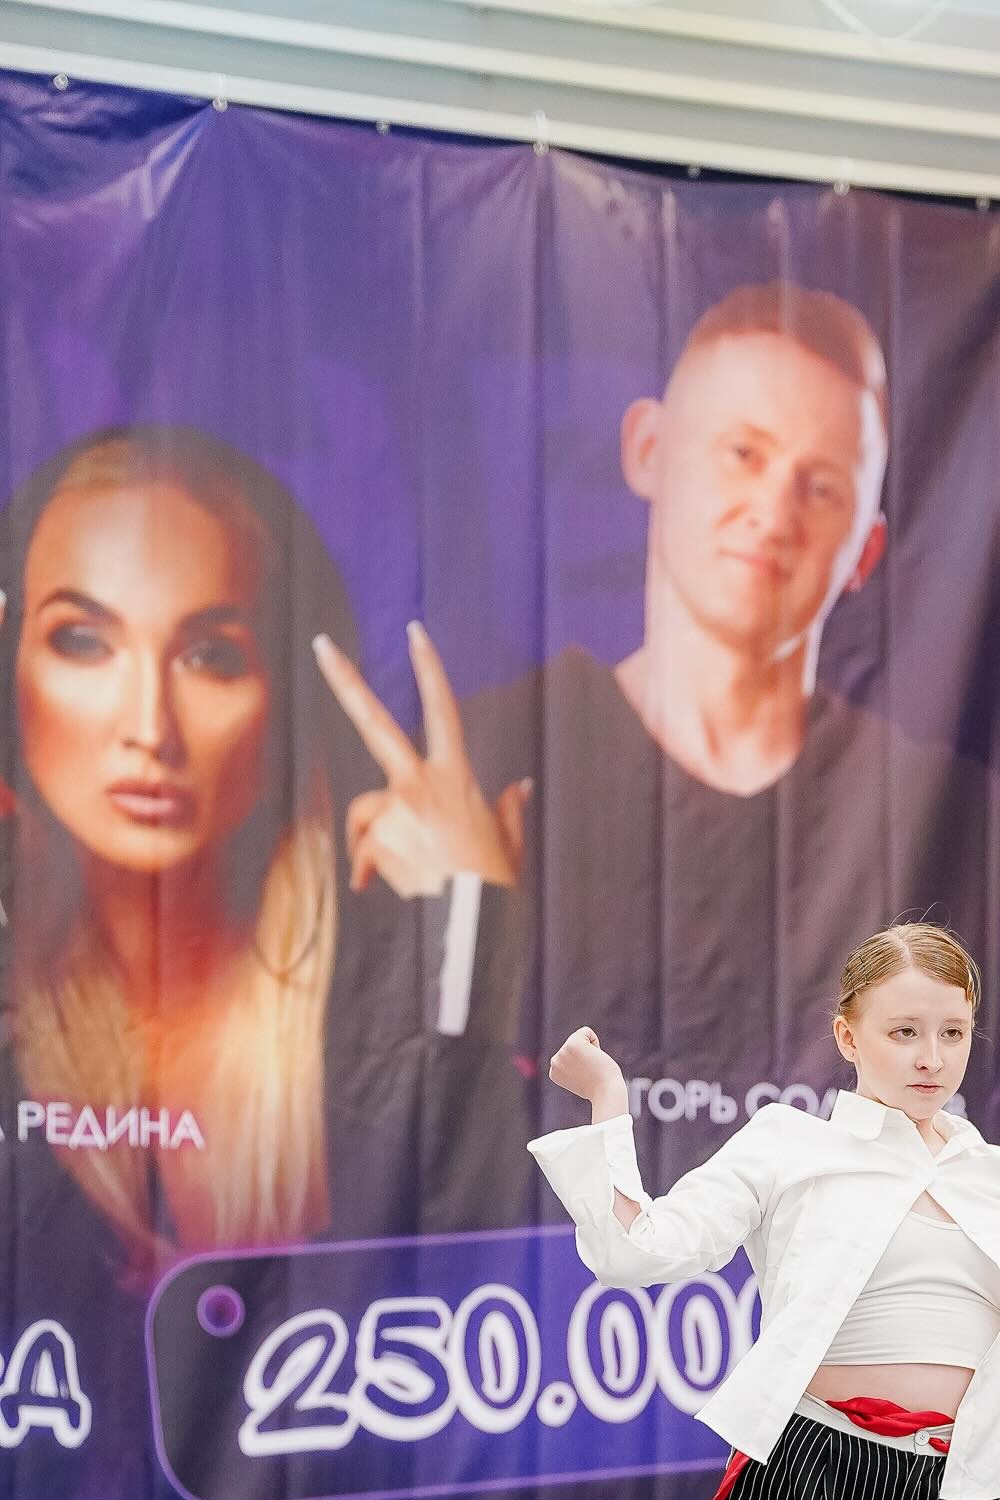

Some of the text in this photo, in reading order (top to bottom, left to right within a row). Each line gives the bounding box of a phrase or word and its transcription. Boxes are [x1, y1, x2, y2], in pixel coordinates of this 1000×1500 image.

[16, 1100, 206, 1151] РЕДИНА
[628, 1077, 738, 1125] ГОРЬ
[238, 1272, 760, 1457] 250.00
